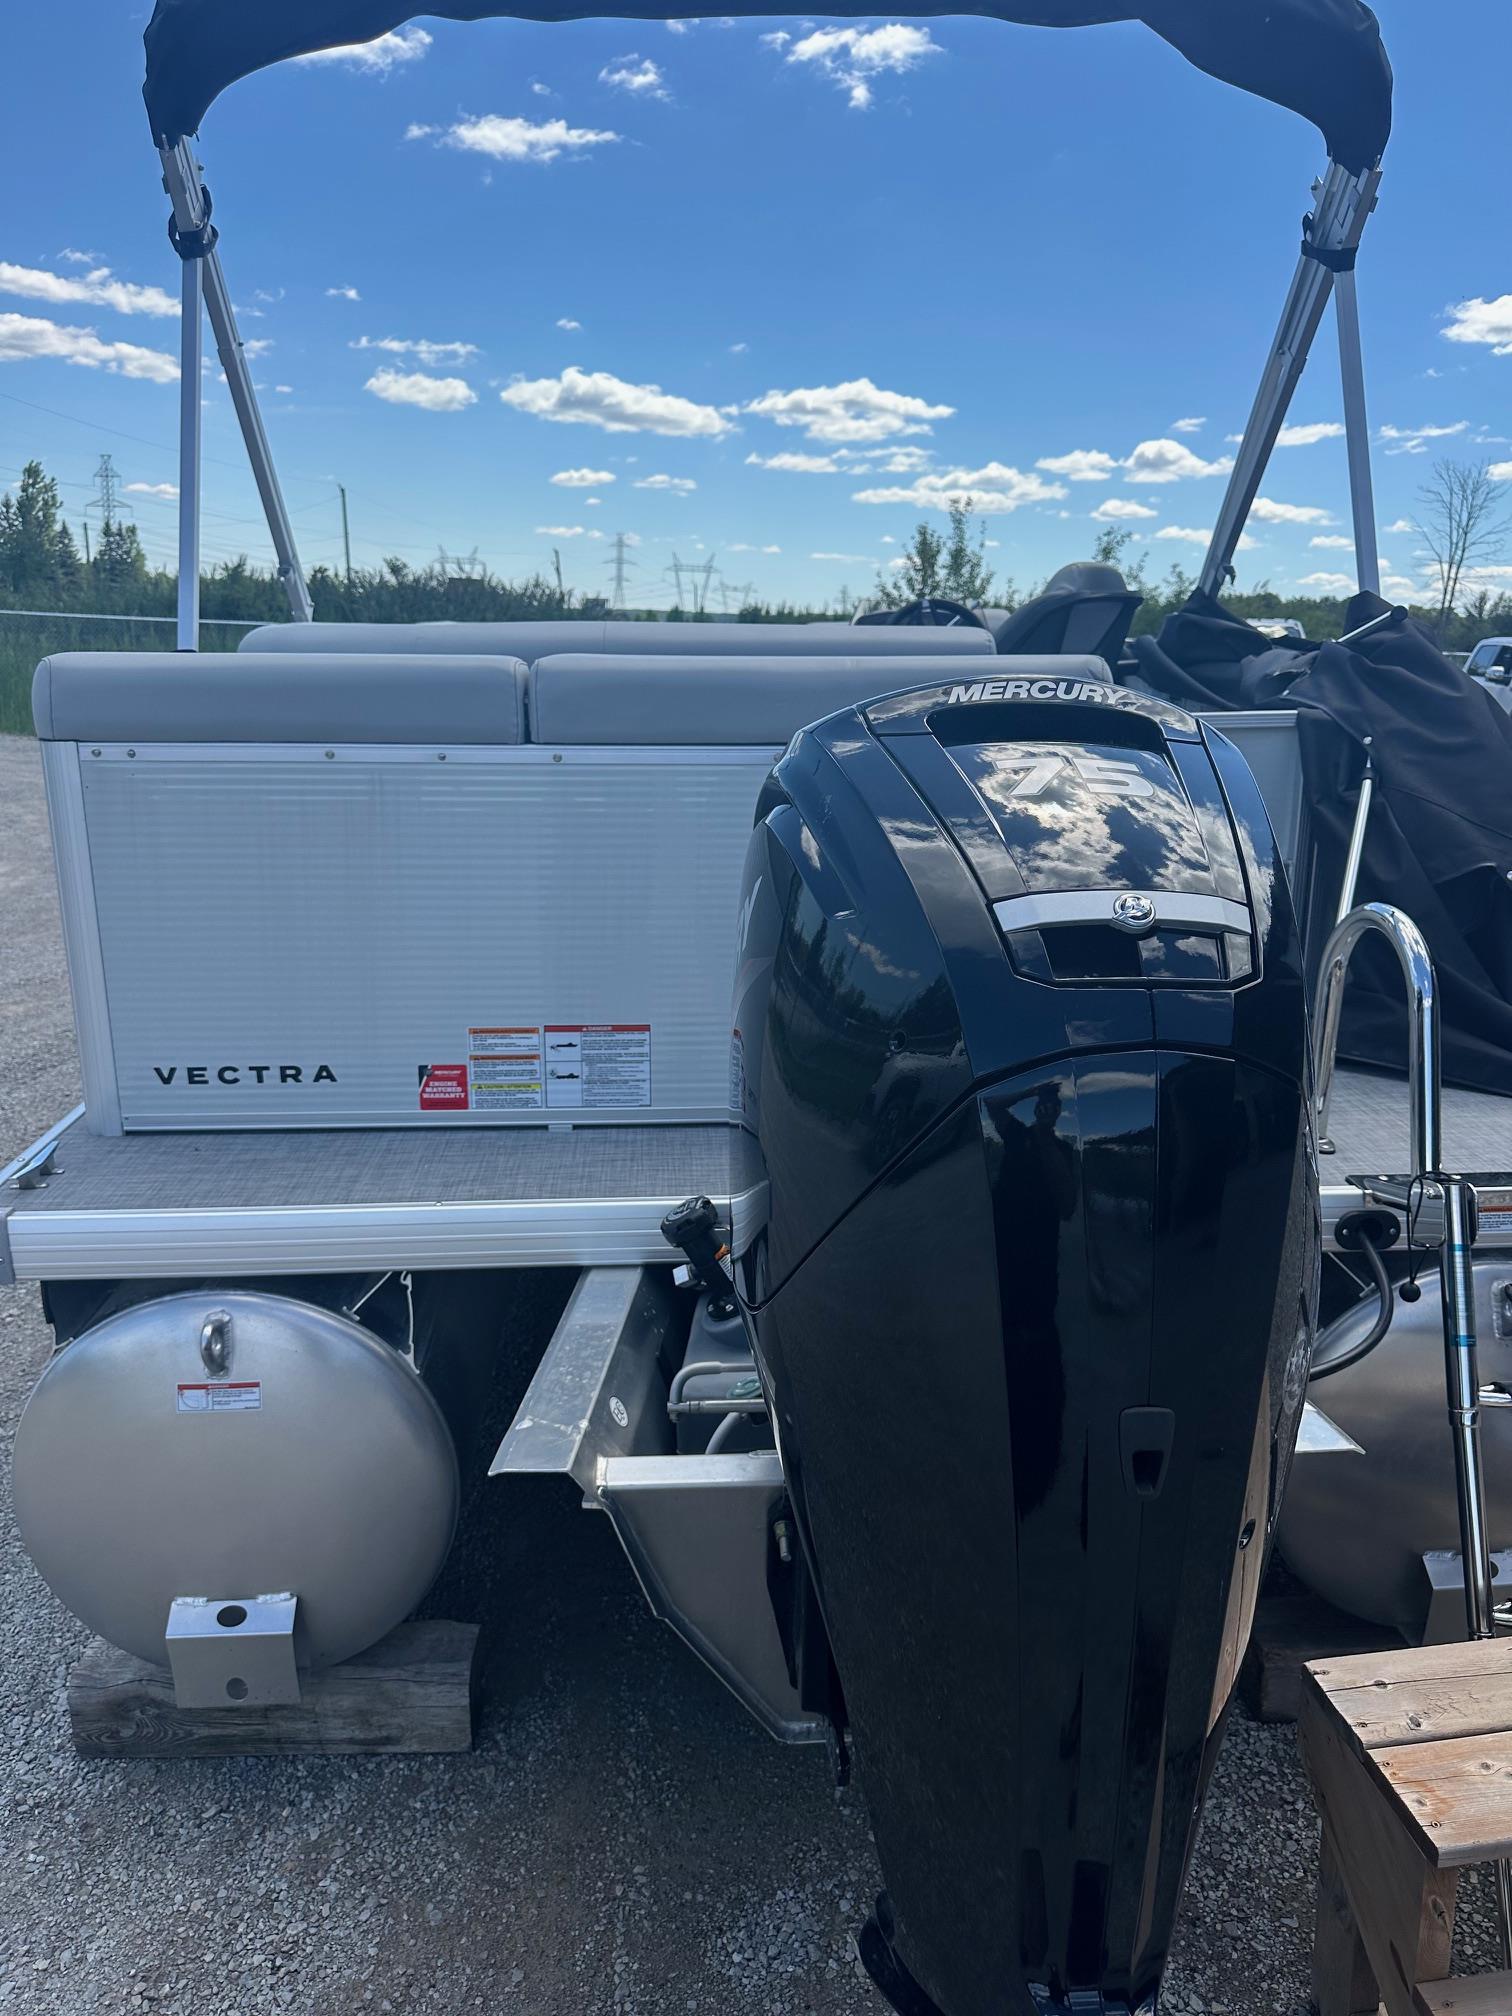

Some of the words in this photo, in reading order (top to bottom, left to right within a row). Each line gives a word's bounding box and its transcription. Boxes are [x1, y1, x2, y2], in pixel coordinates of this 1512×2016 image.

[947, 680, 1128, 705] MERCURY
[994, 755, 1156, 798] 75
[153, 1065, 338, 1085] VECTRA
